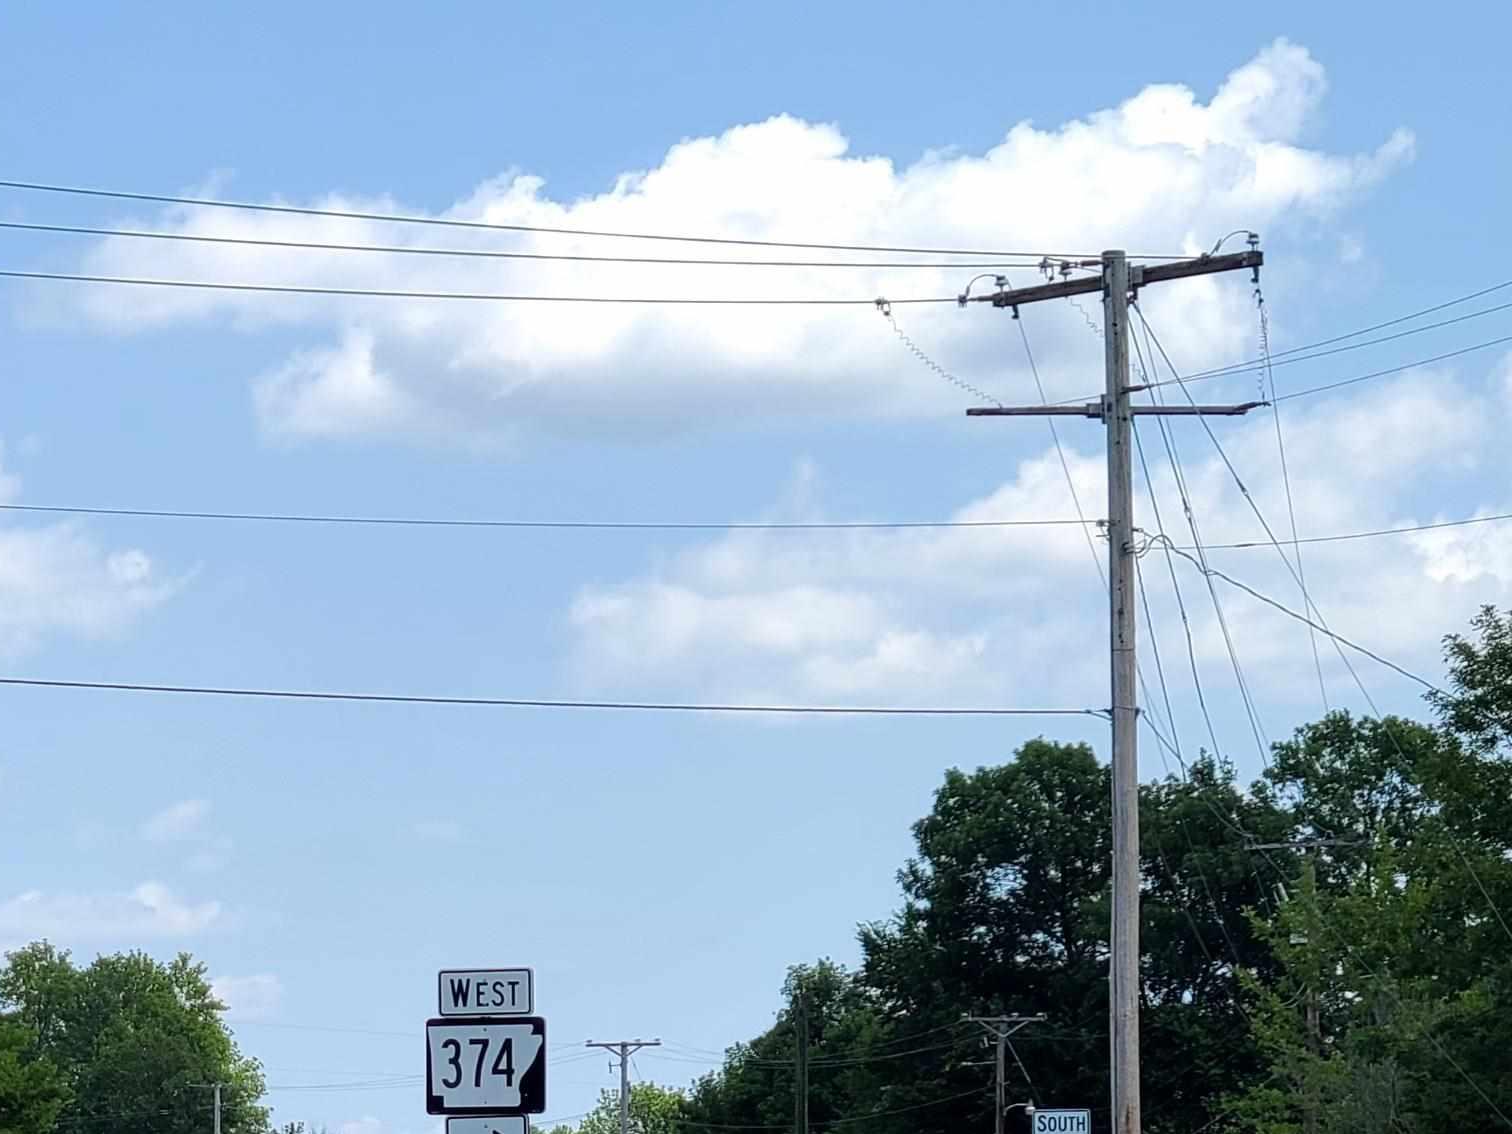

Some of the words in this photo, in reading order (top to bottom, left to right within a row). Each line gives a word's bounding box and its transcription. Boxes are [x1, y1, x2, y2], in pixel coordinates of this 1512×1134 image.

[449, 977, 521, 1008] WEST
[440, 1037, 515, 1089] 374
[1037, 1114, 1086, 1132] SOUTH
